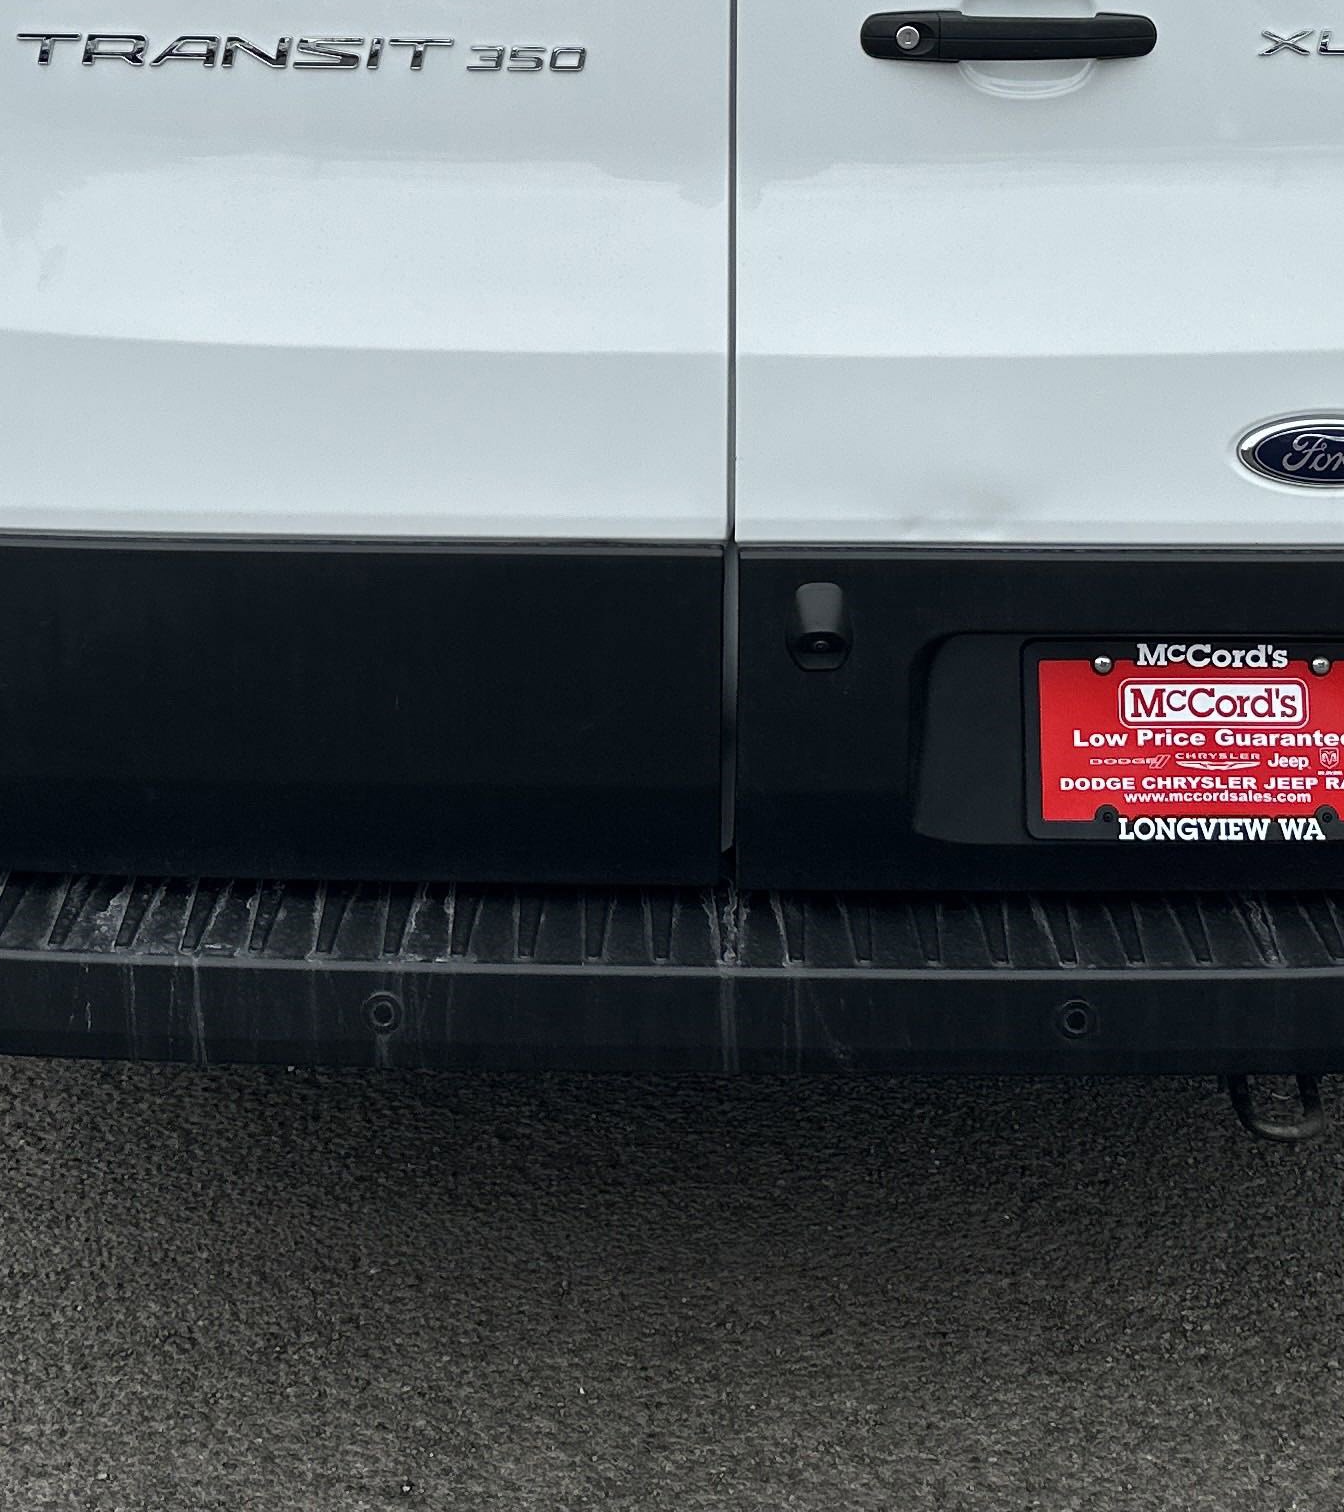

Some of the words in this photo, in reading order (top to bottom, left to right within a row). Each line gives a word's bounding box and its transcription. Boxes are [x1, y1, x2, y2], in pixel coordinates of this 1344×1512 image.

[16, 32, 455, 70] TRANSIT
[466, 45, 586, 72] 350
[1136, 643, 1288, 668] McCord's
[1130, 687, 1298, 719] McCord's
[1073, 729, 1128, 747] Low
[1137, 728, 1206, 747] Price
[1175, 752, 1261, 760] CHRYSLER
[1267, 753, 1309, 771] Jeep
[1060, 777, 1136, 791] DODGE
[1141, 777, 1258, 790] CHRYSLER
[1263, 777, 1319, 790] JEEP
[1123, 790, 1312, 804] www.mccordsales.com
[1118, 817, 1272, 841] LONGVIEW
[1277, 817, 1326, 841] WA
